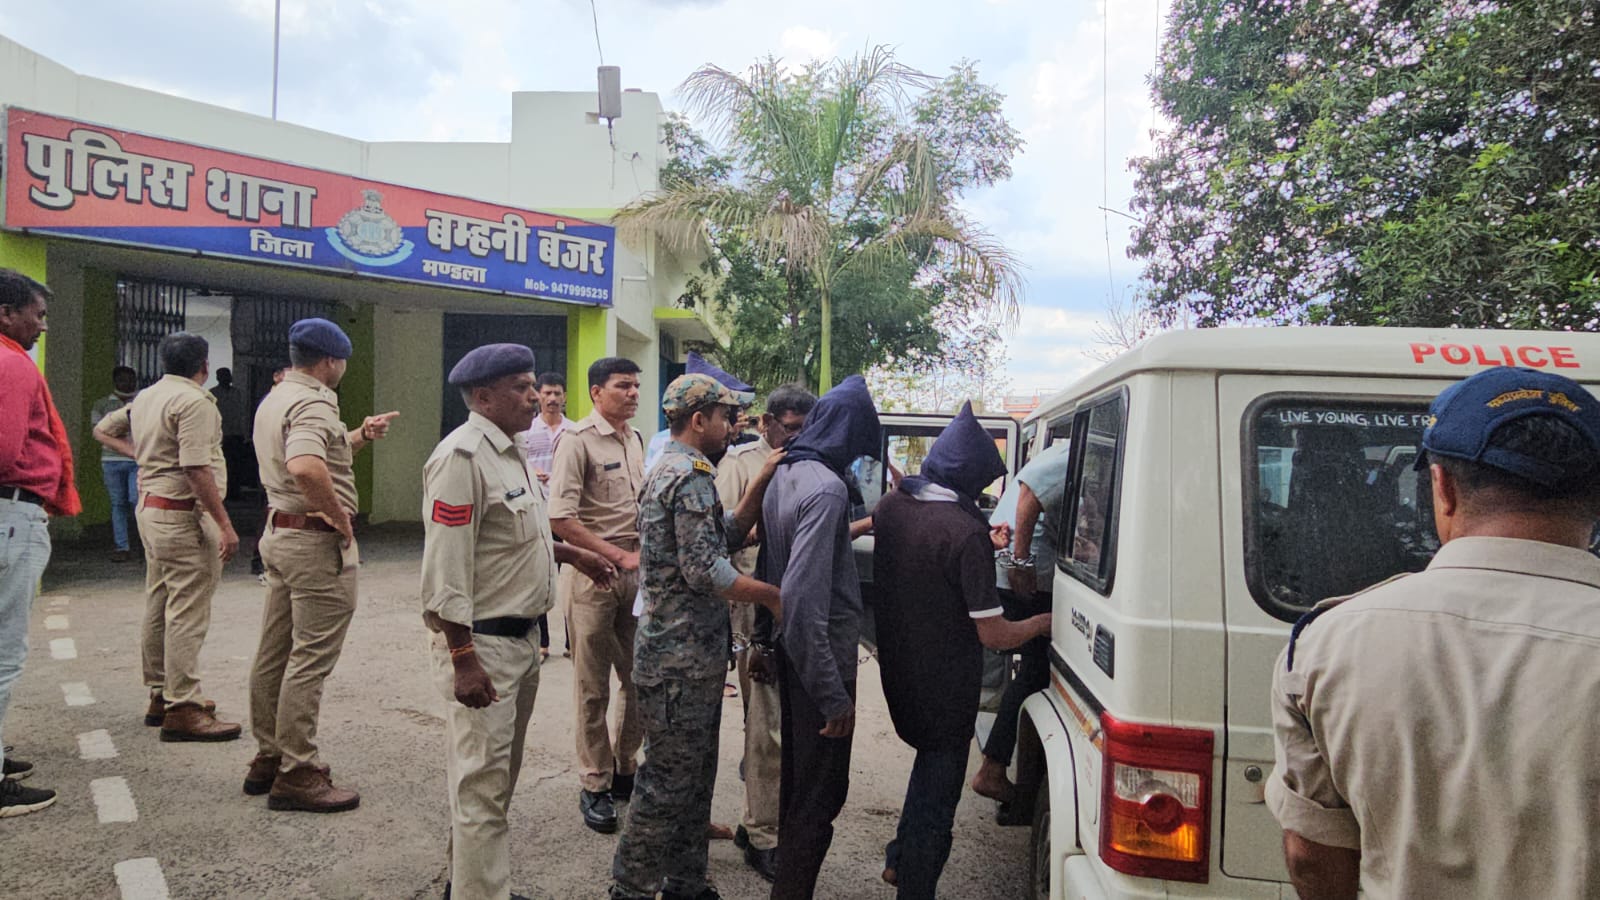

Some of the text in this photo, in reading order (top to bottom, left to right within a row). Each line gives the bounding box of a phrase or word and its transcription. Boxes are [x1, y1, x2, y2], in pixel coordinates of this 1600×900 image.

[22, 128, 607, 275] पुलिस थाना बम्हनी बंजर
[250, 229, 488, 284] जिला मण्डला
[525, 278, 609, 300] Mob- 9479995235
[1410, 343, 1580, 368] POLICE
[1280, 411, 1312, 423] LIVE
[1375, 415, 1408, 426] LIVE
[1412, 415, 1431, 427] FR
